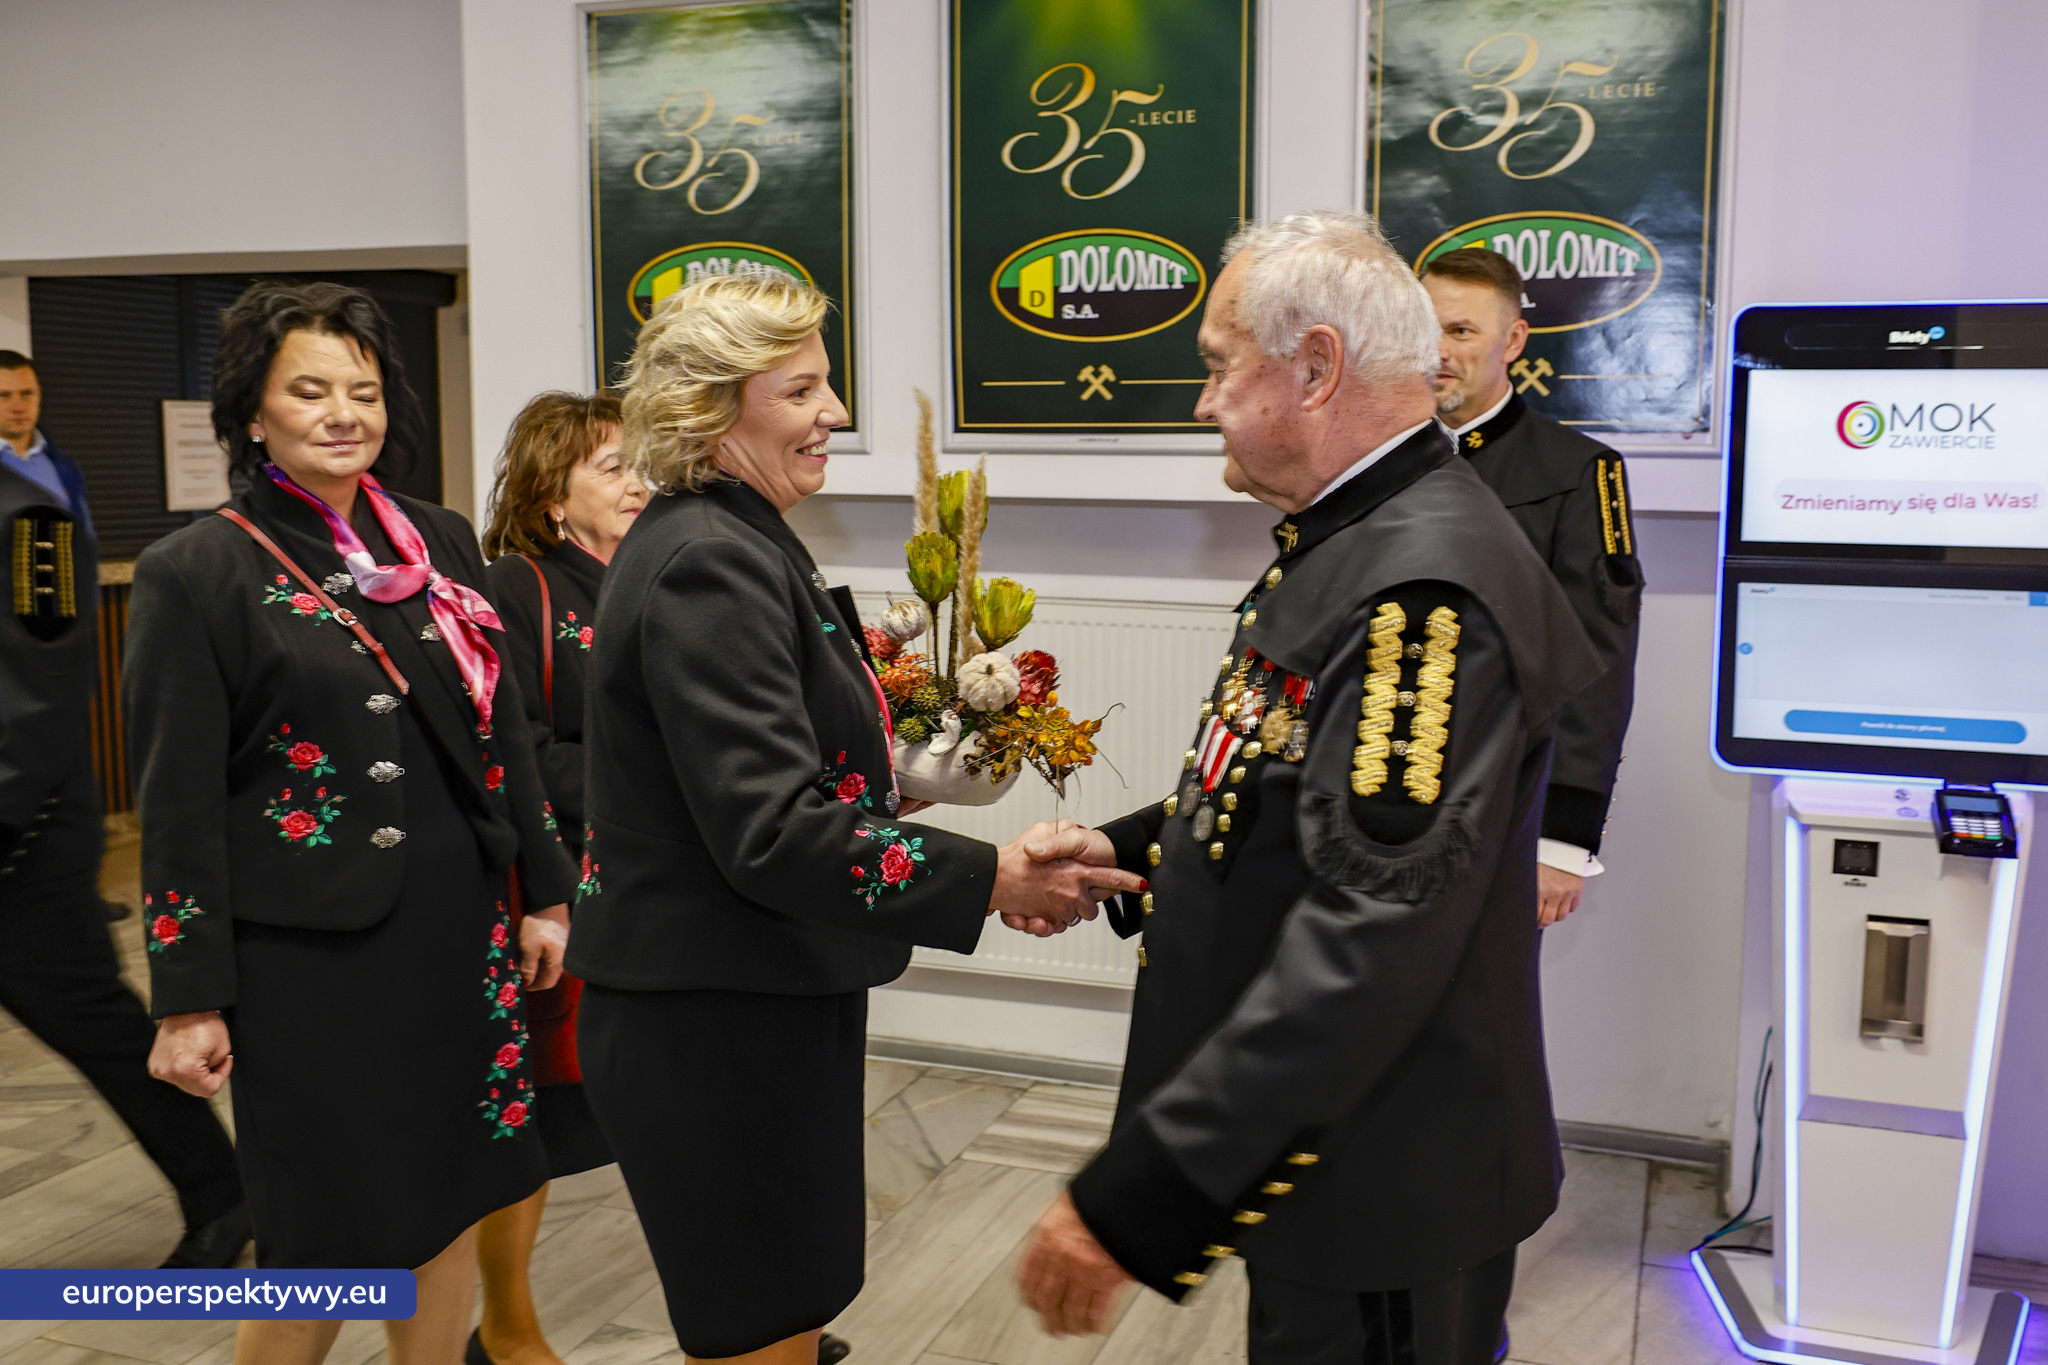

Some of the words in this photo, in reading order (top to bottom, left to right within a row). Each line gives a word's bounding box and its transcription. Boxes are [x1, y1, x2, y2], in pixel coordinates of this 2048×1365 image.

[1428, 31, 1619, 180] 35
[1001, 62, 1165, 200] 35
[633, 87, 776, 215] 35
[1058, 245, 1189, 294] DOLOMIT
[1491, 228, 1641, 281] DOLOMIT
[1030, 290, 1046, 308] D
[1061, 303, 1100, 320] S.A.
[1889, 403, 1996, 432] MOK
[1889, 434, 1996, 449] ZAWIERCIE
[1781, 494, 1902, 515] Zmieniamy
[1907, 493, 1937, 513] się
[1943, 493, 1976, 509] dla
[1984, 493, 2039, 509] Was!
